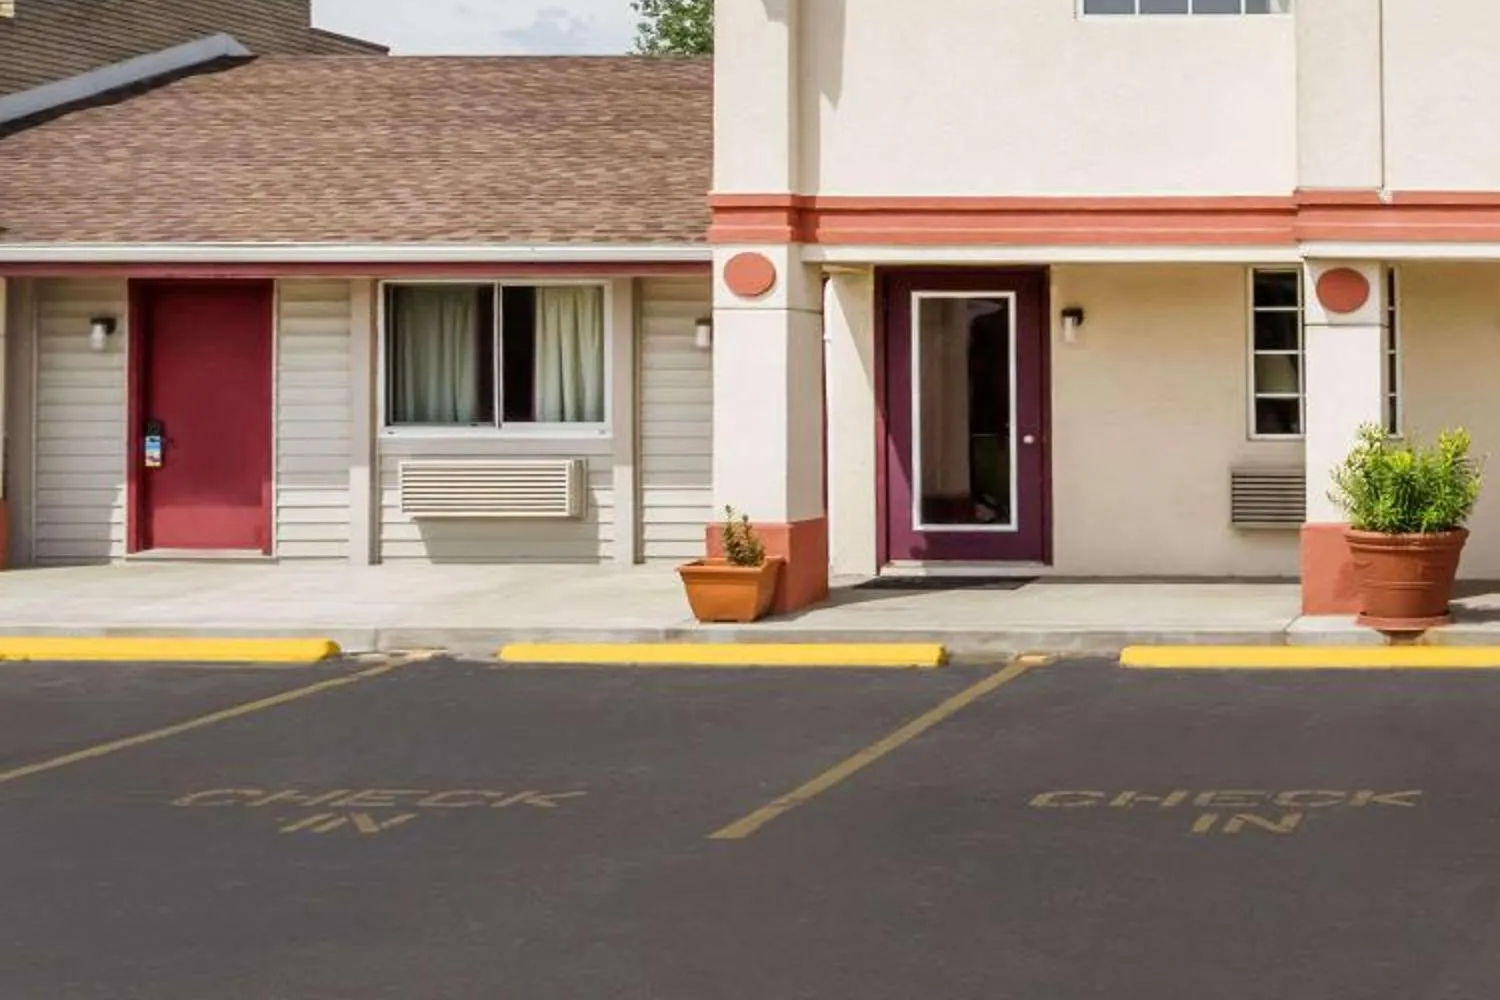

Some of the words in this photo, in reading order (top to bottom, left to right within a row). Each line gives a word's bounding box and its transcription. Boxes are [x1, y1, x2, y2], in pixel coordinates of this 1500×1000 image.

[170, 788, 589, 808] CHECK
[1028, 789, 1424, 807] CHECK
[280, 813, 418, 833] IN
[1191, 812, 1303, 833] IN
